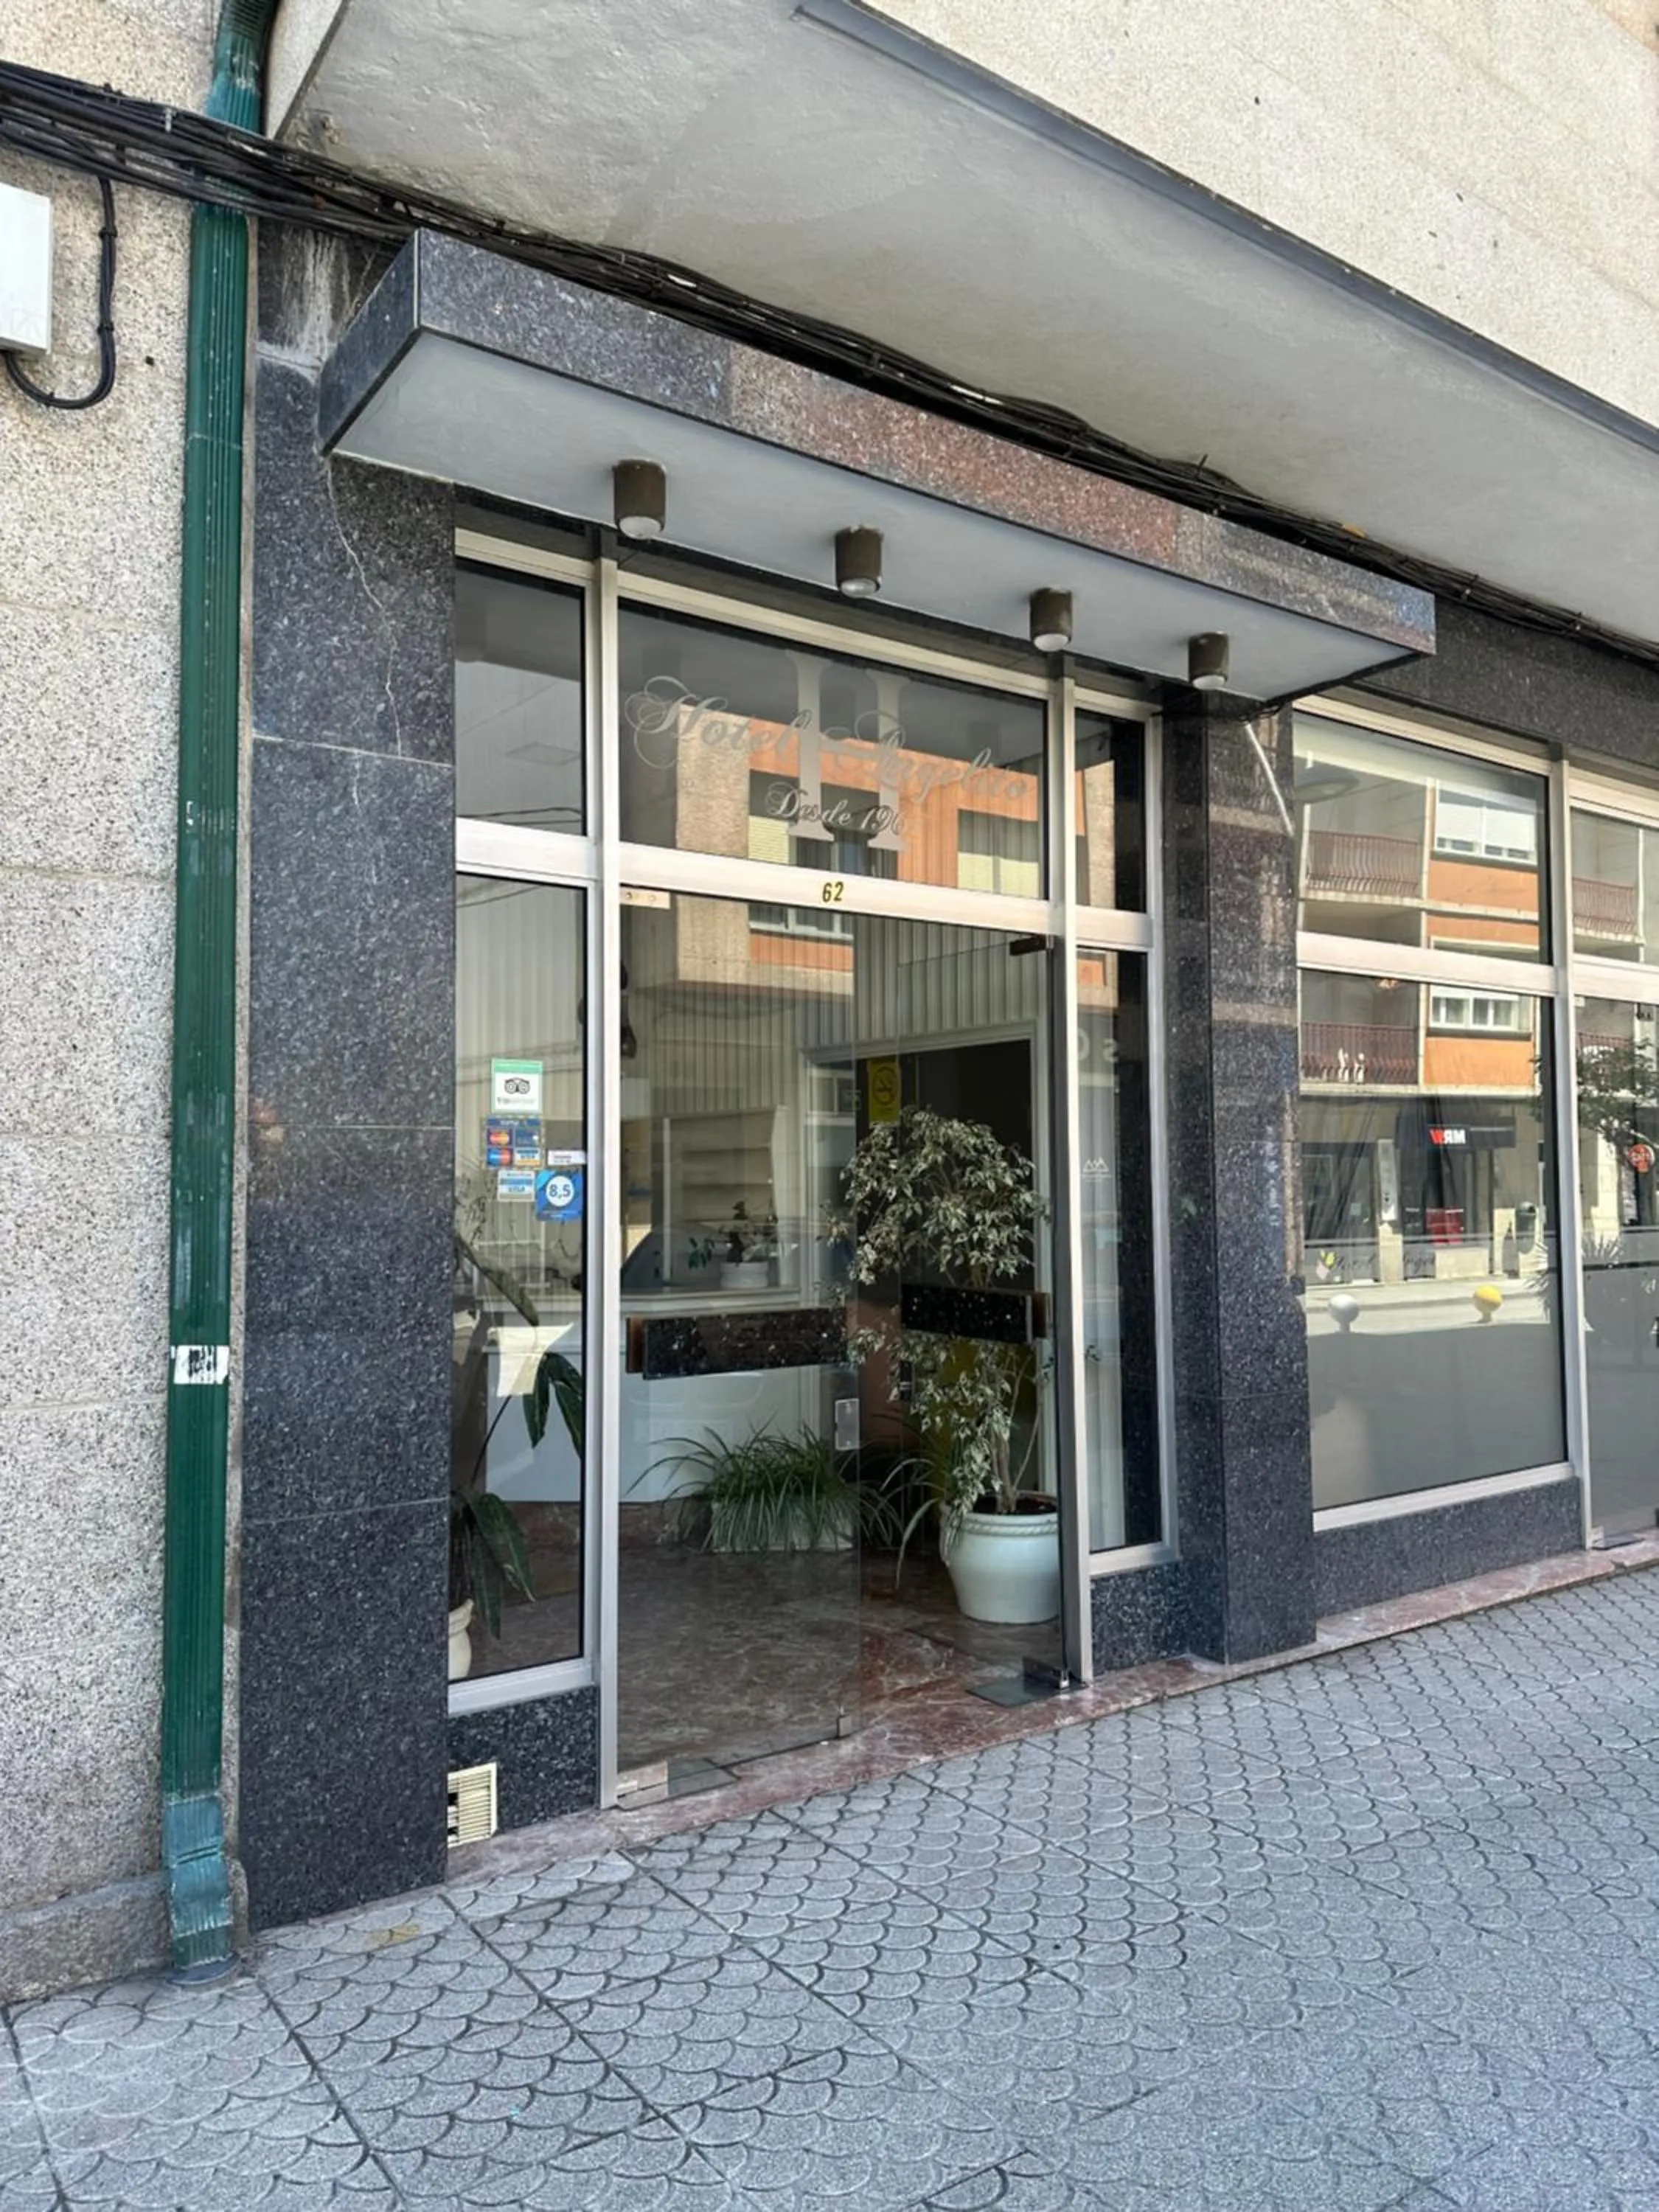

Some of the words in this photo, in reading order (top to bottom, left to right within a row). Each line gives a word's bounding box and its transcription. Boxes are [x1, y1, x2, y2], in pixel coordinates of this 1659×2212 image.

[625, 675, 813, 769] Hotel
[765, 782, 851, 826] Desde
[821, 881, 844, 903] 62
